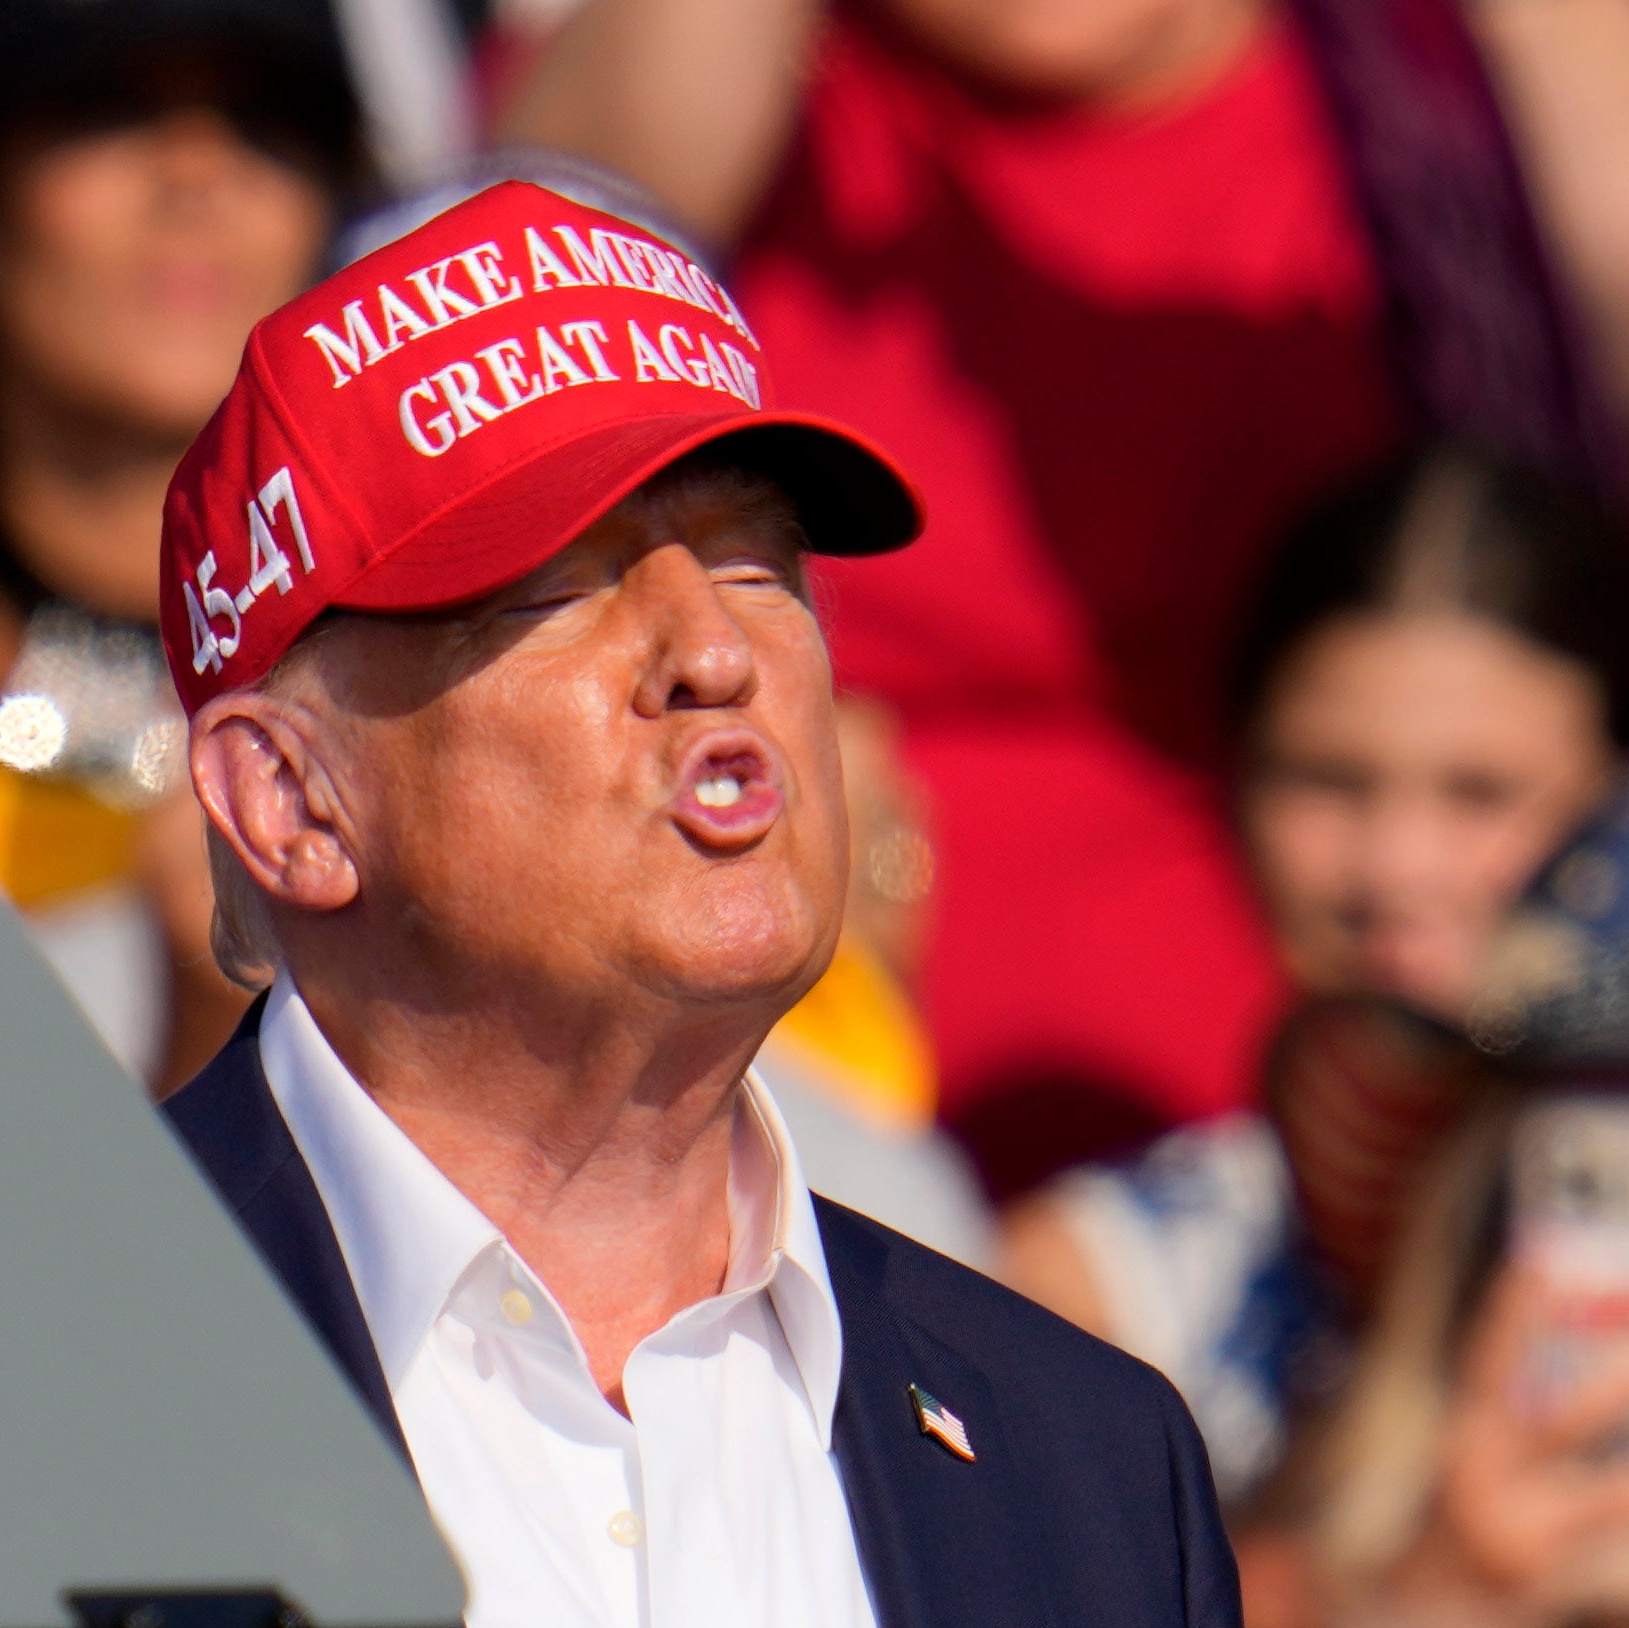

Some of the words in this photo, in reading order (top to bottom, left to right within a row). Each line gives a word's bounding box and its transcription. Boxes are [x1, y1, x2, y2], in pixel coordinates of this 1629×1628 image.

[303, 240, 524, 389] MAKE
[524, 224, 761, 352] AMERICA
[398, 320, 621, 457] GREAT
[627, 319, 762, 411] AGAIN
[182, 465, 316, 677] 45-47
